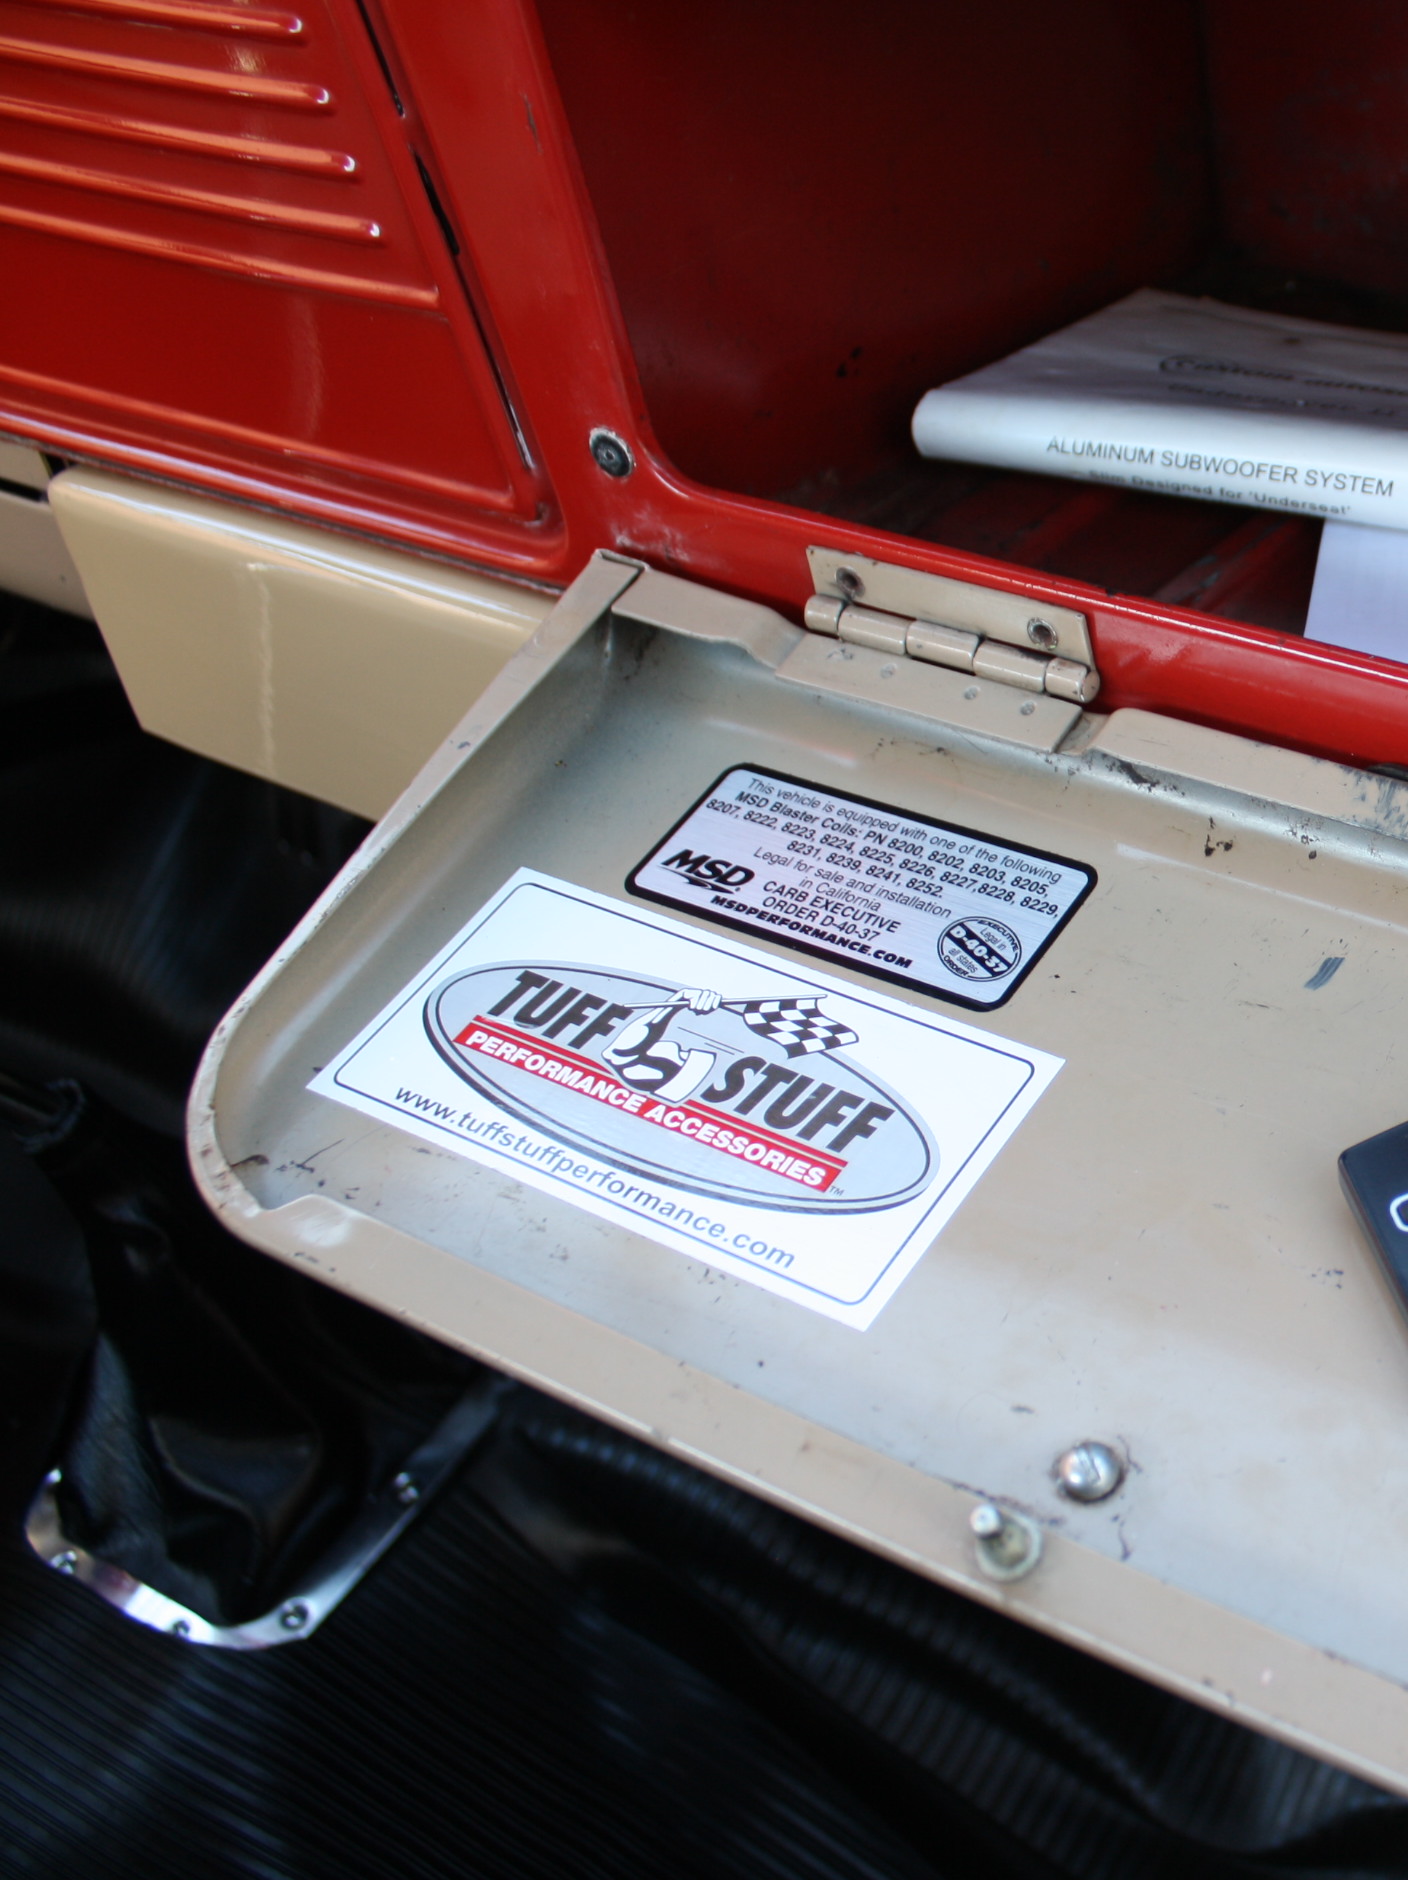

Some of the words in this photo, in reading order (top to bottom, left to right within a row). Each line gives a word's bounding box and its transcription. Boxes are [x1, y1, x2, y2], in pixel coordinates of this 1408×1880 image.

[1046, 436, 1154, 466] ALUMINUM
[1160, 450, 1298, 484] SUBWOOFER
[1304, 469, 1395, 497] SYSTEM
[1220, 486, 1242, 500] for
[706, 799, 741, 818] 8207,
[744, 811, 778, 830] 8222,
[781, 822, 816, 841] 8223,
[820, 834, 855, 853] 8224,
[859, 846, 894, 866] 8225,
[899, 858, 936, 879] 8226,
[1020, 896, 1059, 918] 8229,
[735, 791, 769, 809] MSD
[770, 804, 820, 824] Blaster
[863, 829, 888, 846] PN
[888, 837, 924, 858] 8200,
[928, 849, 965, 871] 8202,
[969, 863, 1006, 884] 8203,
[1010, 876, 1049, 898] 8205,
[749, 778, 774, 794] This
[777, 789, 821, 808] vehicle
[823, 801, 835, 813] is
[837, 808, 899, 832] equipped
[900, 824, 928, 841] with
[929, 835, 956, 849] one
[958, 843, 975, 855] of
[975, 848, 998, 863] the
[1001, 855, 1062, 885] following
[661, 849, 755, 886] MSD
[754, 847, 793, 866] Legal
[794, 859, 815, 873] for
[814, 867, 844, 883] sale
[846, 875, 876, 893] and
[876, 886, 952, 918] installation
[787, 840, 821, 861] 8231,
[825, 852, 861, 873] 8239,
[866, 865, 901, 886] 8241,
[905, 878, 944, 898] 8252.
[799, 877, 813, 889] in
[816, 882, 882, 911] California
[711, 895, 914, 968] MSDPERFORMANCE.COM
[762, 896, 820, 923] ORDER
[820, 915, 881, 941] D-40-37
[763, 881, 809, 902] CARB
[809, 895, 901, 933] EXECUTIVE
[943, 955, 969, 976] ORDER
[949, 925, 1009, 972] D-40-37
[487, 969, 635, 1050] TUFF
[700, 1056, 895, 1153] STUFF
[465, 1031, 649, 1113] PERFORMANCE
[643, 1104, 828, 1186] ACCESSORIES
[395, 1087, 796, 1270] www.tuffstuffperformance.com
